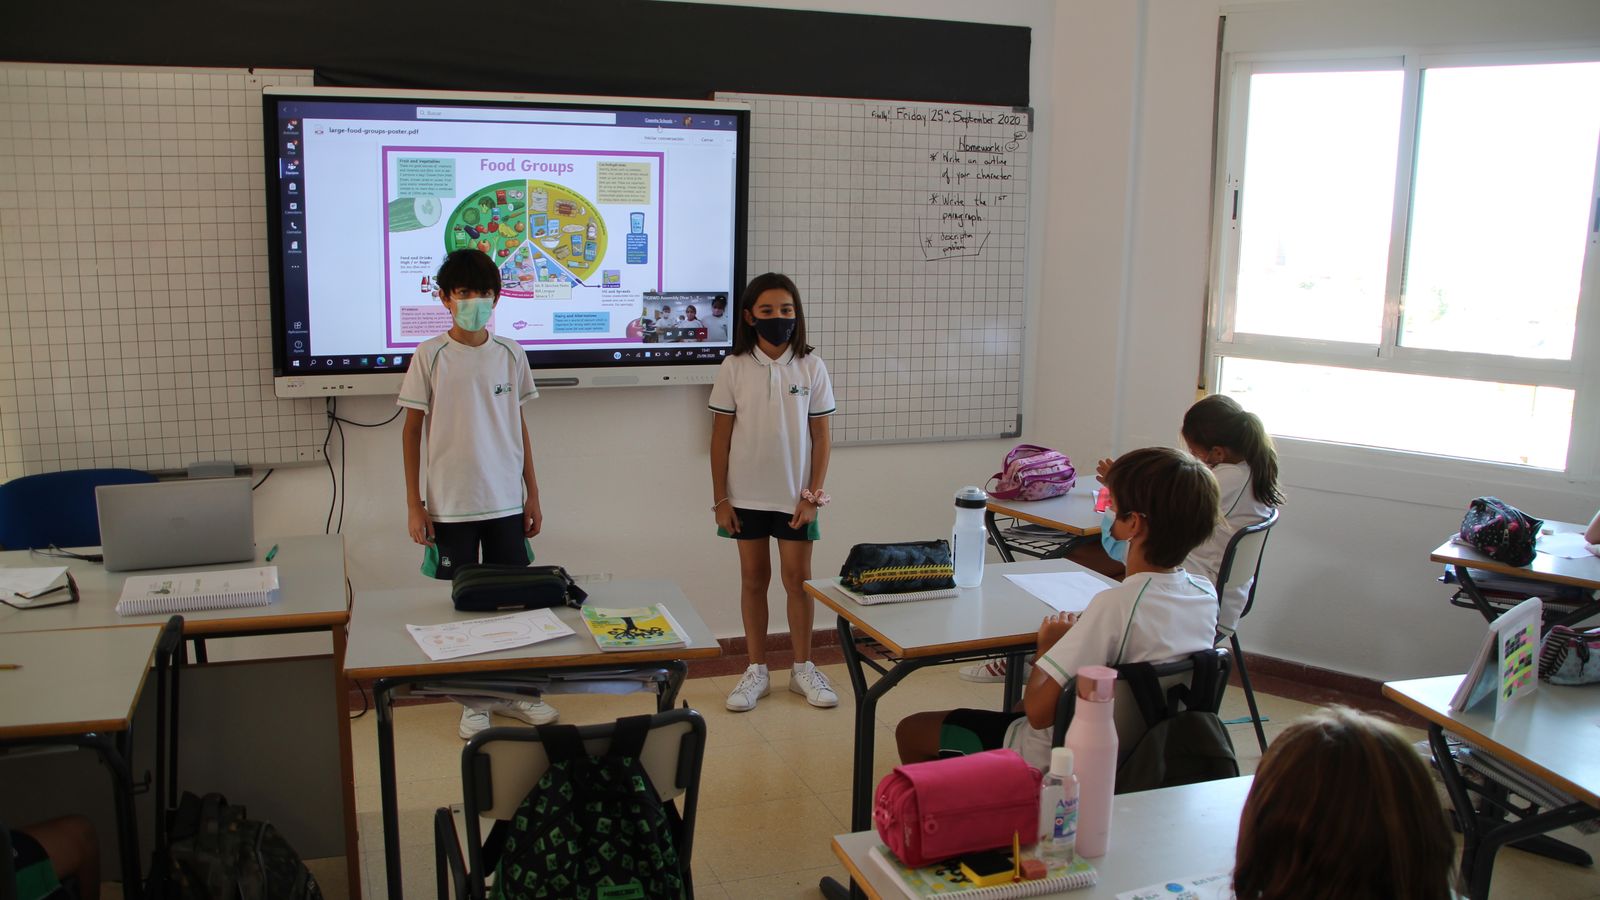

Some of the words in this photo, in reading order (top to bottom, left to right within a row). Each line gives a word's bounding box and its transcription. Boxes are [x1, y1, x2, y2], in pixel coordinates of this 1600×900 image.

[896, 107, 927, 126] Friday
[953, 110, 994, 128] September
[997, 114, 1021, 126] 2020
[328, 127, 419, 136] large-food-groups-poster.pdf
[958, 135, 1004, 153] Homework:
[942, 151, 960, 163] Write
[480, 157, 516, 172] Food
[520, 159, 574, 176] Groups
[957, 172, 970, 184] your
[976, 168, 1012, 182] character
[942, 192, 964, 206] Write
[974, 191, 987, 206] the
[942, 208, 982, 228] paragraph
